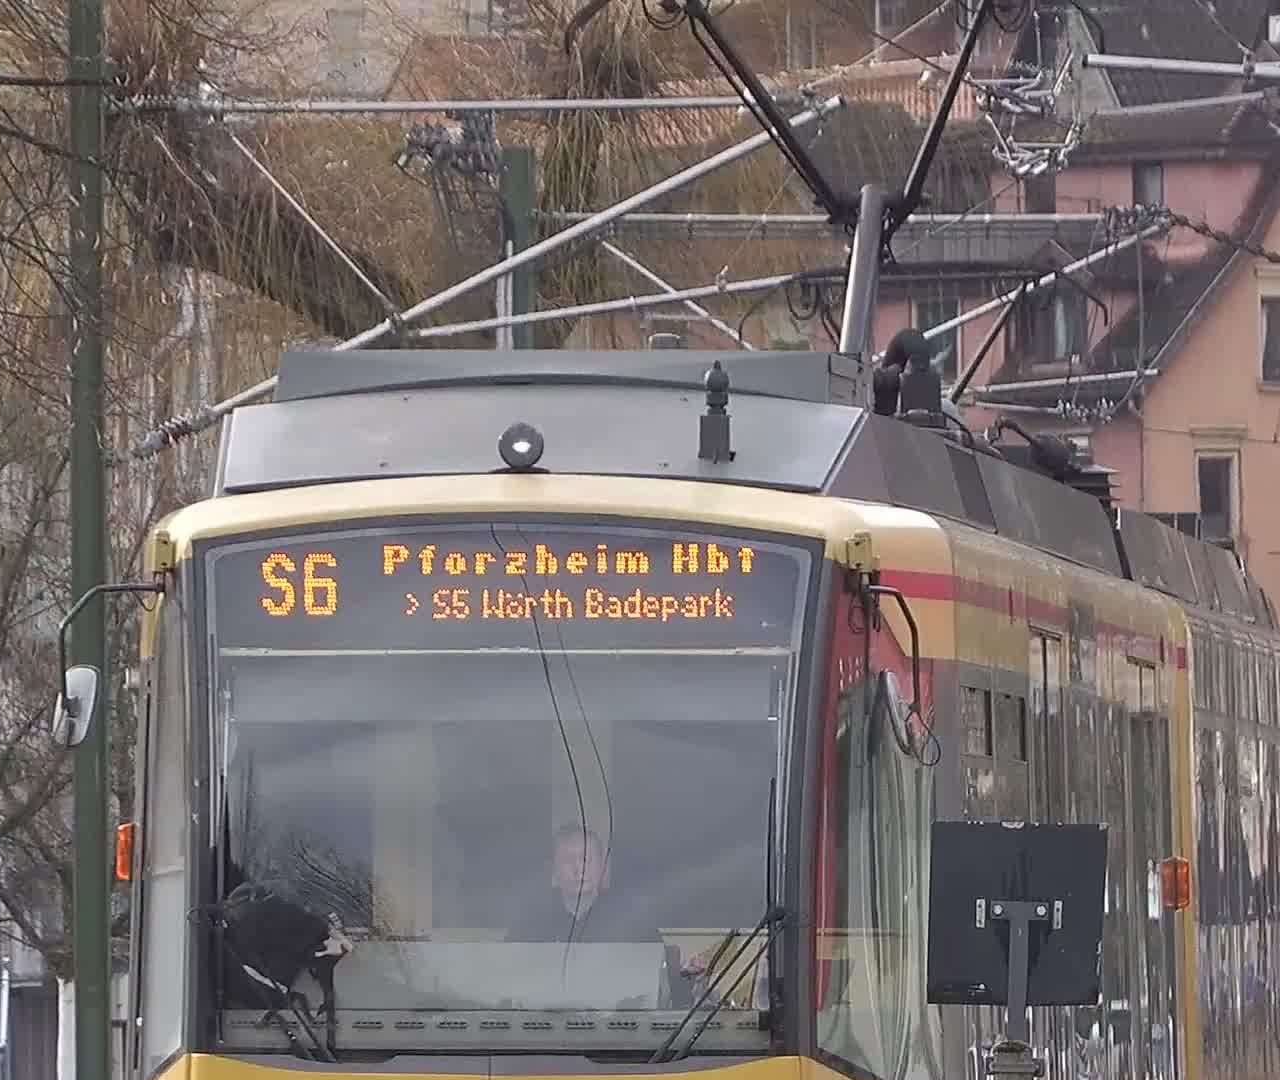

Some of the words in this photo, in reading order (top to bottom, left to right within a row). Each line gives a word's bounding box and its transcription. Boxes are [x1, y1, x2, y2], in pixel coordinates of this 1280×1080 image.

[383, 544, 650, 575] Pforzheim
[261, 553, 338, 615] S6
[433, 589, 471, 619] S5
[481, 588, 573, 619] Wörth
[585, 588, 734, 622] Badepark
